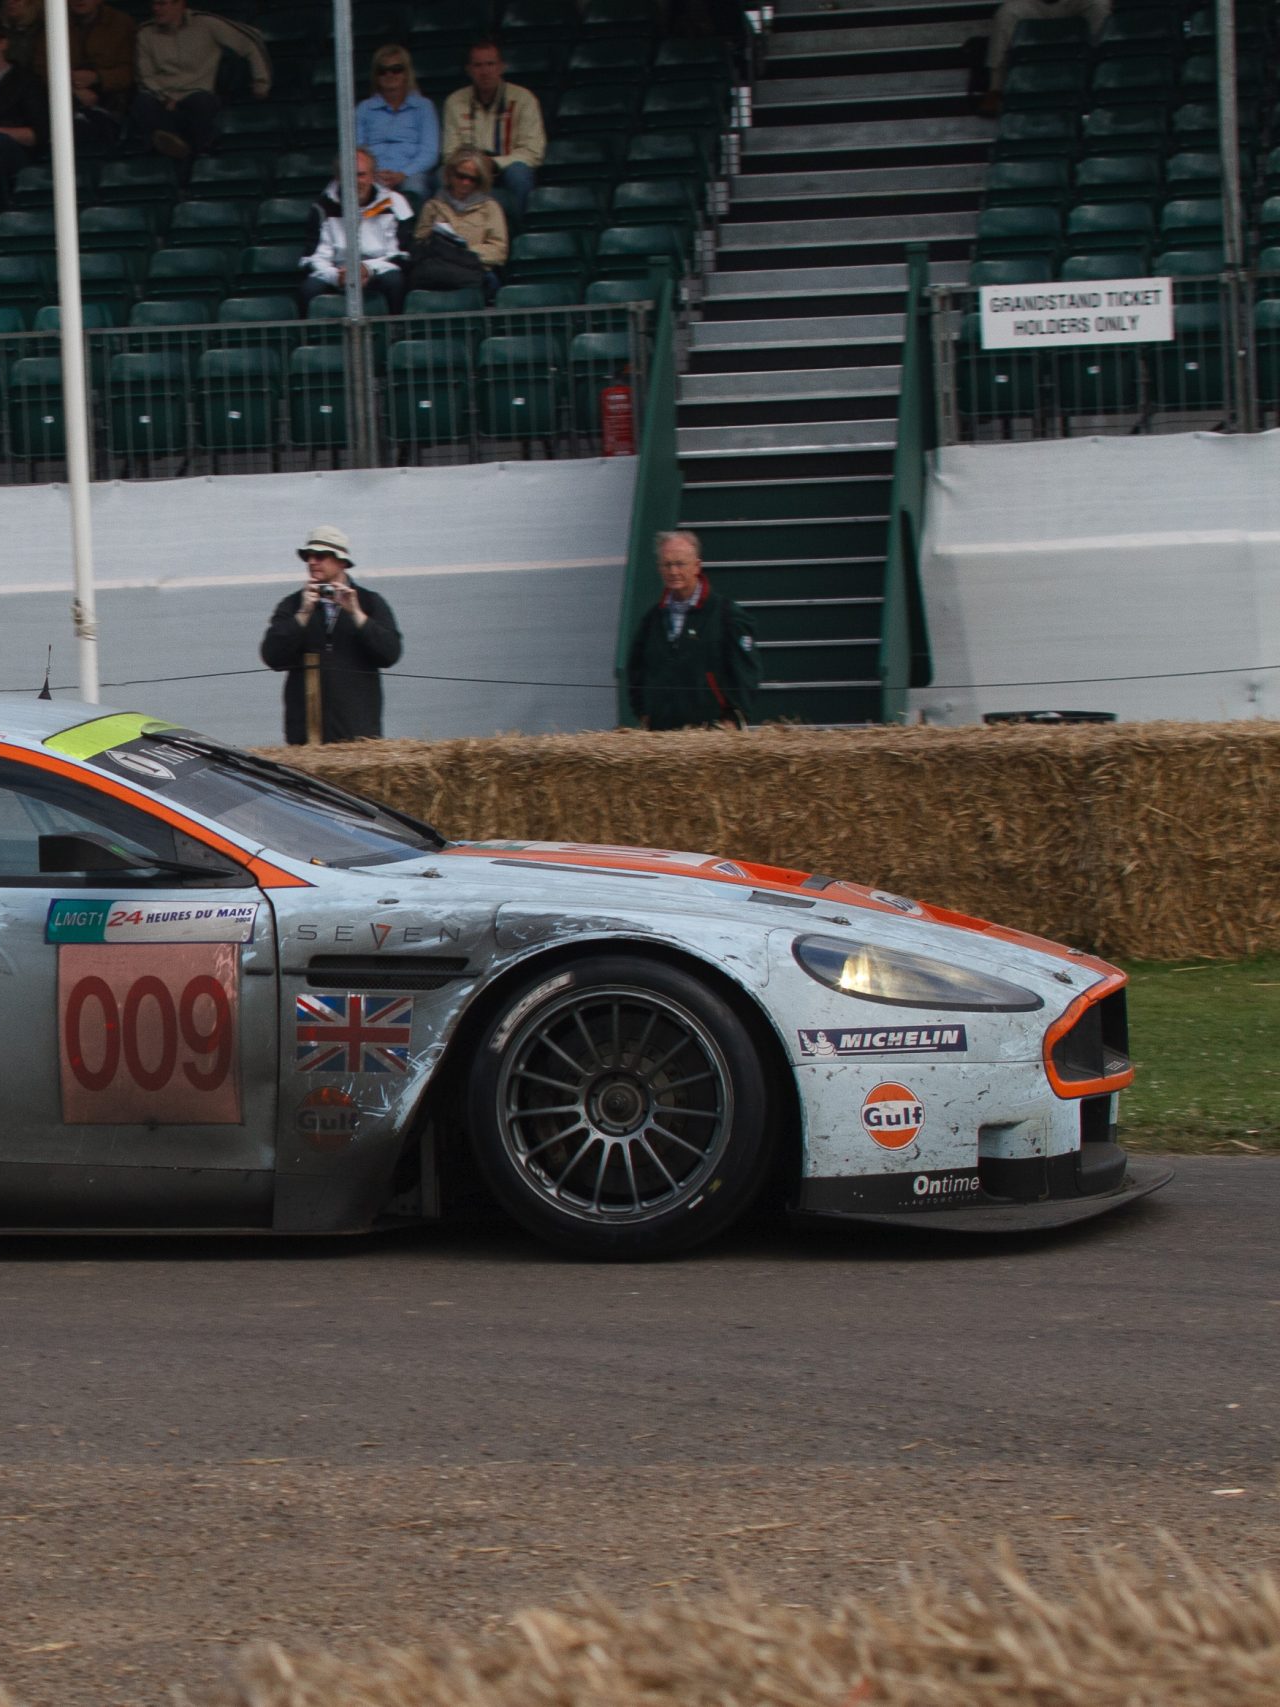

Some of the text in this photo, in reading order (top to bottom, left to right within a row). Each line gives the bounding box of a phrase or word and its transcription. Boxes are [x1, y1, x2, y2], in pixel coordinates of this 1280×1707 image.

[989, 289, 1162, 313] GRANDSTAND TICKET
[1013, 315, 1140, 336] HOLDERS ONLY
[55, 912, 104, 926] LMGT1
[107, 907, 253, 928] 24 HEURES DU MANS
[65, 974, 233, 1092] 009
[840, 1029, 960, 1049] MICHELIN
[862, 1106, 924, 1127] Gulf
[913, 1175, 980, 1195] Ontime
